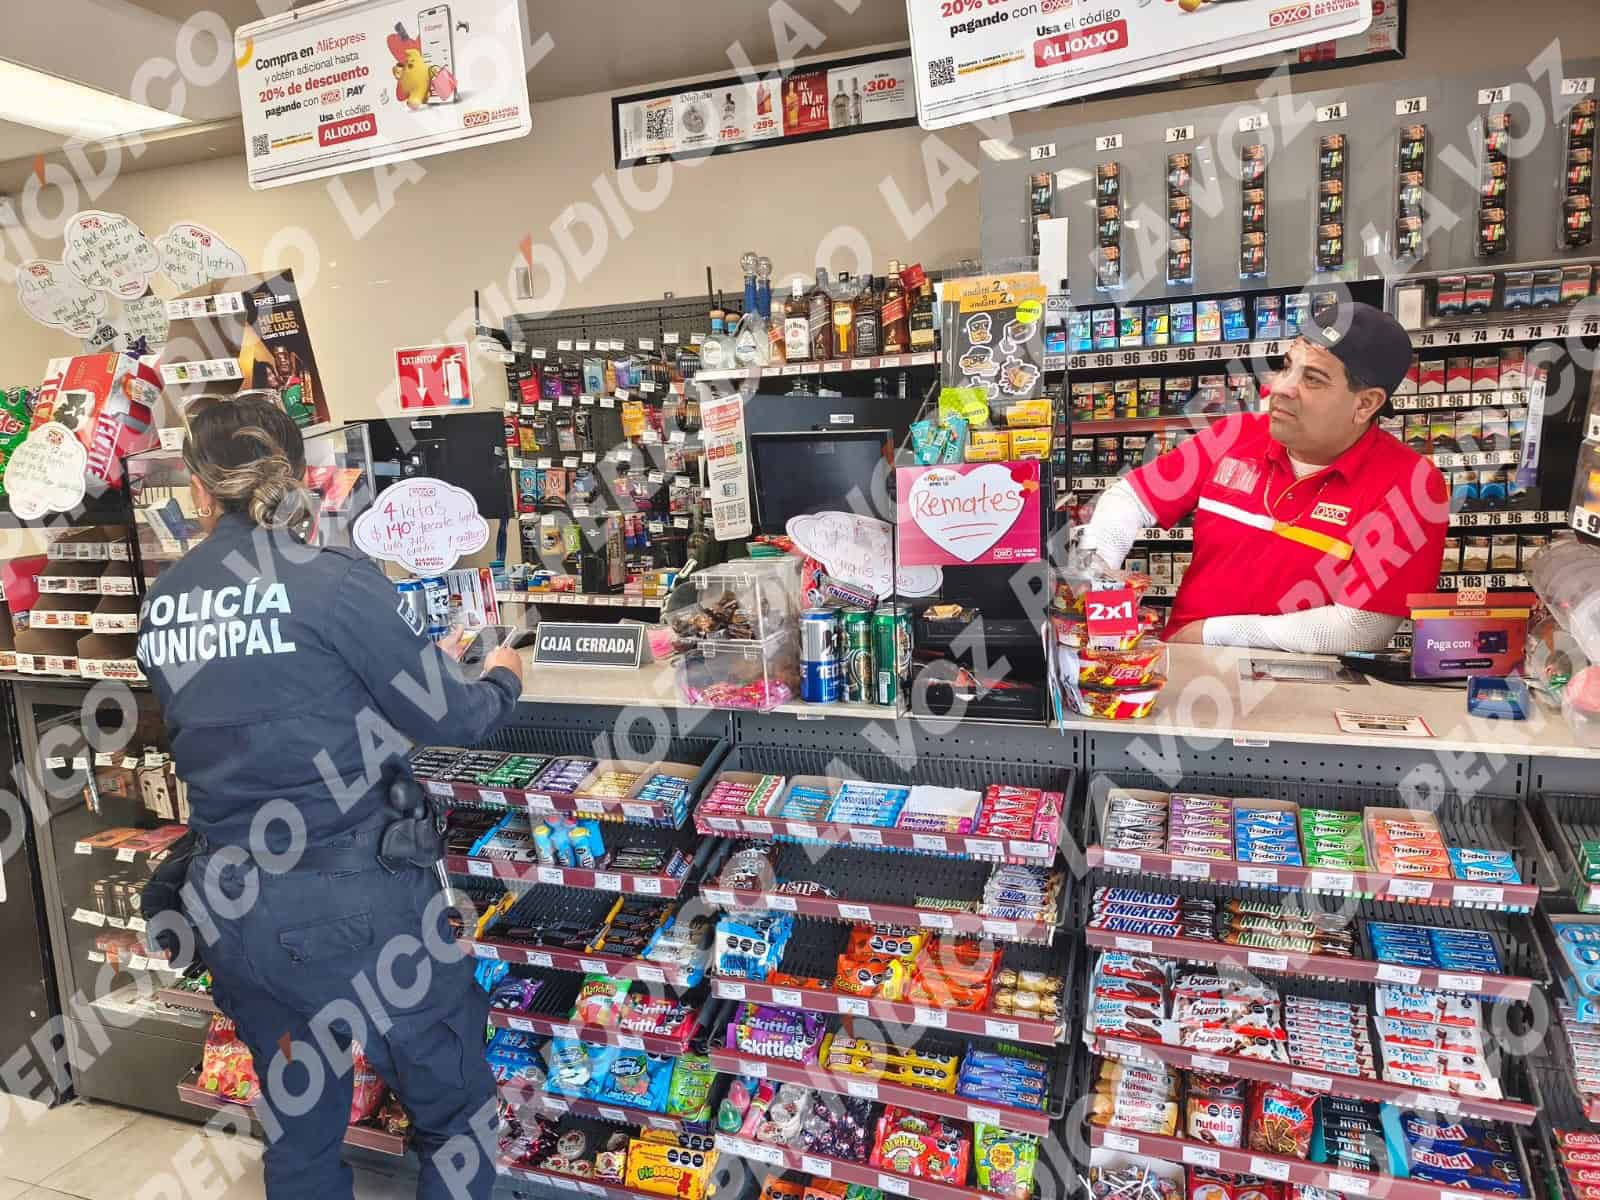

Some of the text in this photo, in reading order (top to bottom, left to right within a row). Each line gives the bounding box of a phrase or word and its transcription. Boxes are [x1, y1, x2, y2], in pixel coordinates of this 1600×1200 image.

[950, 12, 1009, 38] pagando
[1012, 4, 1038, 18] con
[1036, 7, 1121, 37] Usa el código
[1269, 5, 1311, 27] OXXO
[256, 32, 367, 70] Compra en AliExpress
[1042, 29, 1119, 60] ALIOXXO
[335, 52, 360, 65] hasta
[259, 65, 369, 103] 20% de descuento
[265, 84, 366, 119] pagando con PAY
[320, 112, 335, 122] Usa
[323, 121, 372, 141] ALIOXXO
[914, 482, 1021, 519] Remates
[384, 502, 397, 521] 4
[1089, 602, 1134, 620] 2x1
[136, 618, 297, 668] MUNICIPAL
[541, 636, 635, 653] CAJA CERRADA
[1427, 639, 1471, 652] Paga con
[1313, 811, 1347, 821] Trident
[1249, 827, 1284, 836] Trident
[1312, 825, 1346, 835] Trident
[1392, 846, 1431, 856] Trident
[1459, 852, 1496, 861] Trident
[1464, 868, 1503, 878] Trident
[1108, 887, 1177, 906] SNICKERS
[1106, 902, 1177, 921] SNICKERS
[1106, 917, 1177, 937] SNICKERS
[1190, 975, 1227, 986] bueno
[1192, 1003, 1229, 1015] bueno
[620, 1019, 672, 1036] Skittles
[1193, 1033, 1233, 1043] bueno
[740, 1038, 802, 1061] Skittles
[1196, 1117, 1233, 1133] nutella
[1408, 1121, 1468, 1141] CRUNCH
[1414, 1149, 1474, 1169] CRUNCH
